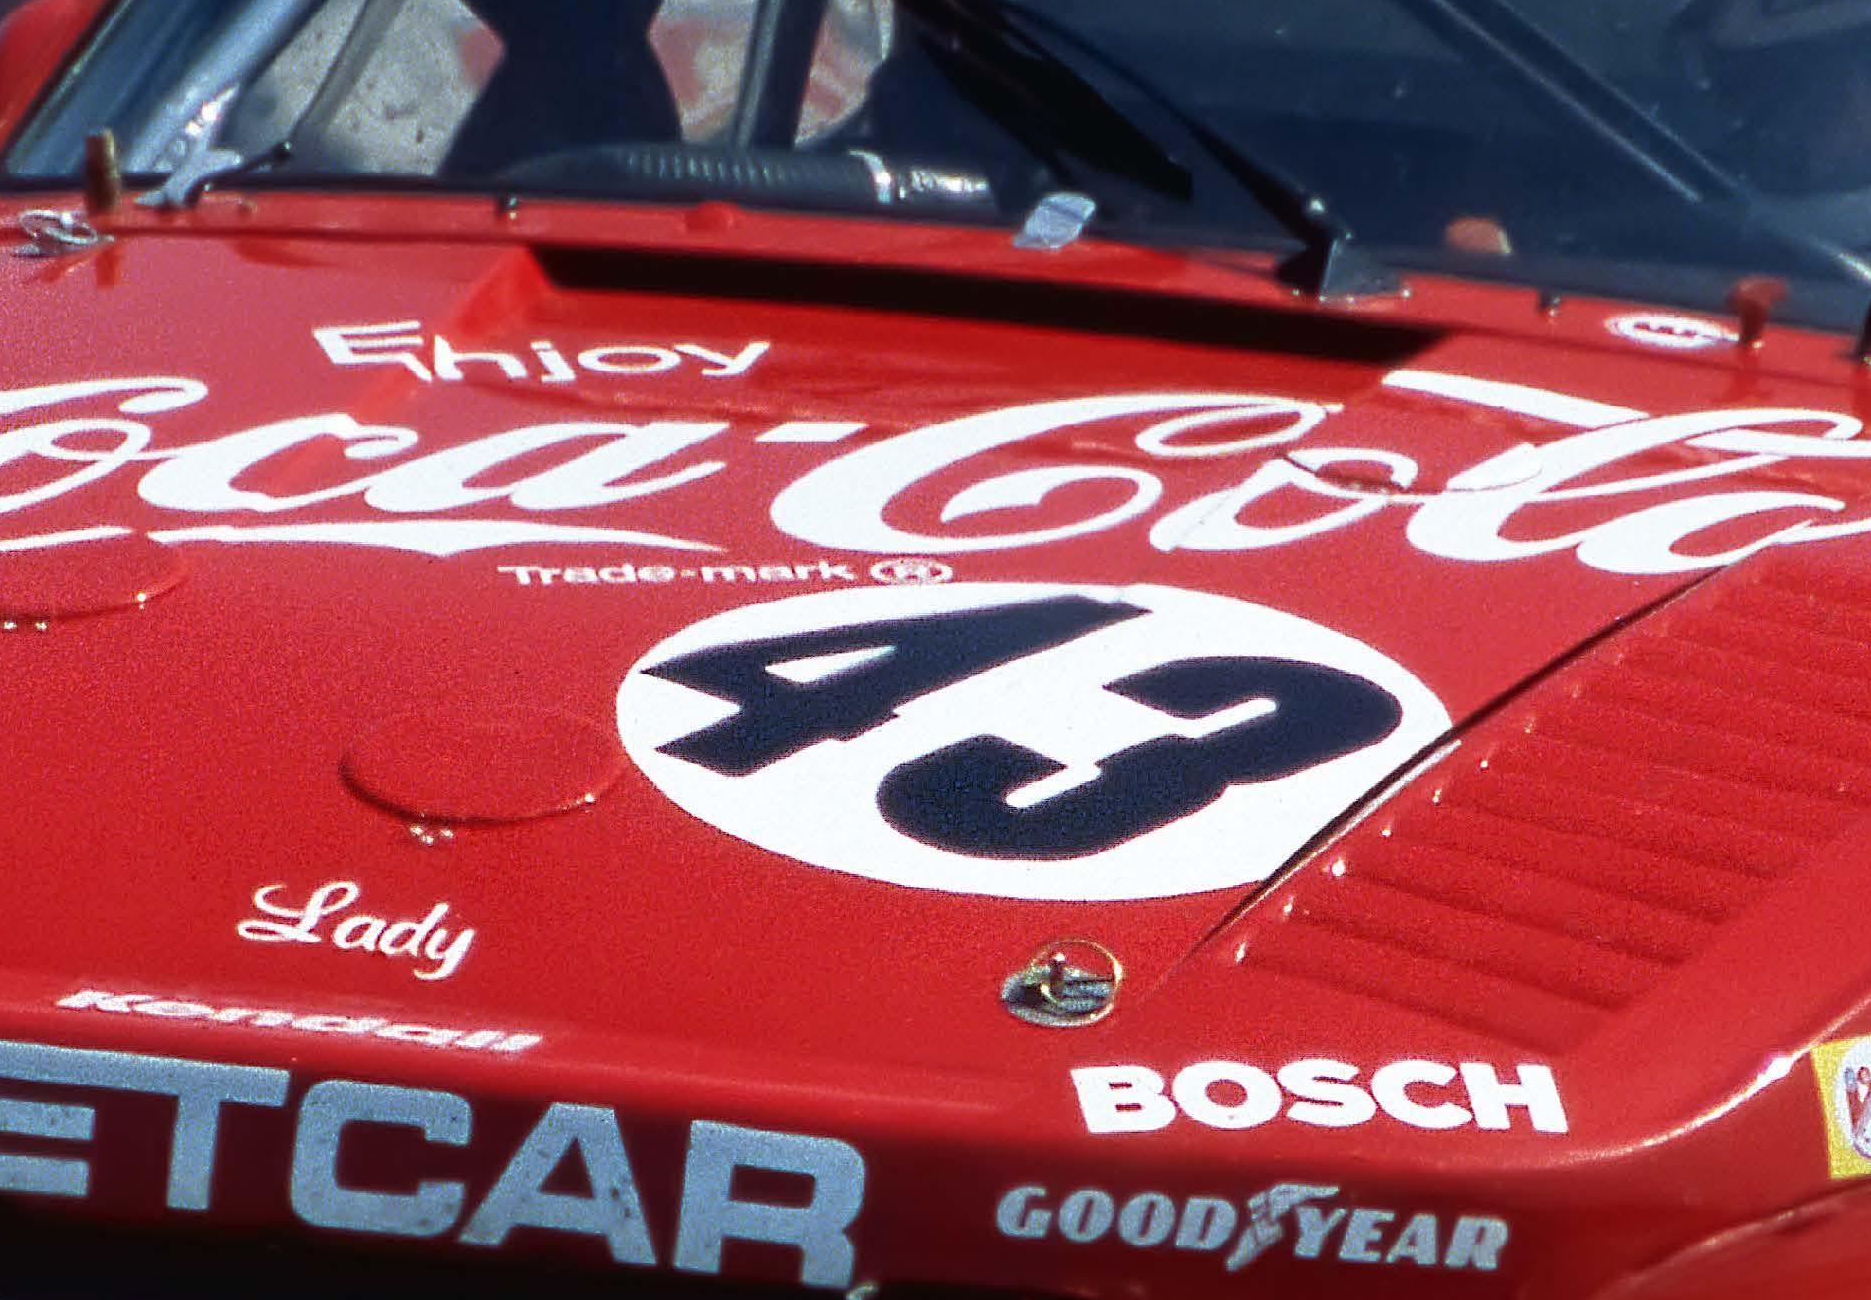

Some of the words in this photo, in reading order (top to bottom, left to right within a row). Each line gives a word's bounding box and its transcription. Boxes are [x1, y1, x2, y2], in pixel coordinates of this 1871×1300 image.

[312, 320, 770, 387] Enjoy
[640, 594, 1403, 860] 43
[236, 880, 476, 981] Lady
[1070, 1058, 1570, 1134] BOSCH
